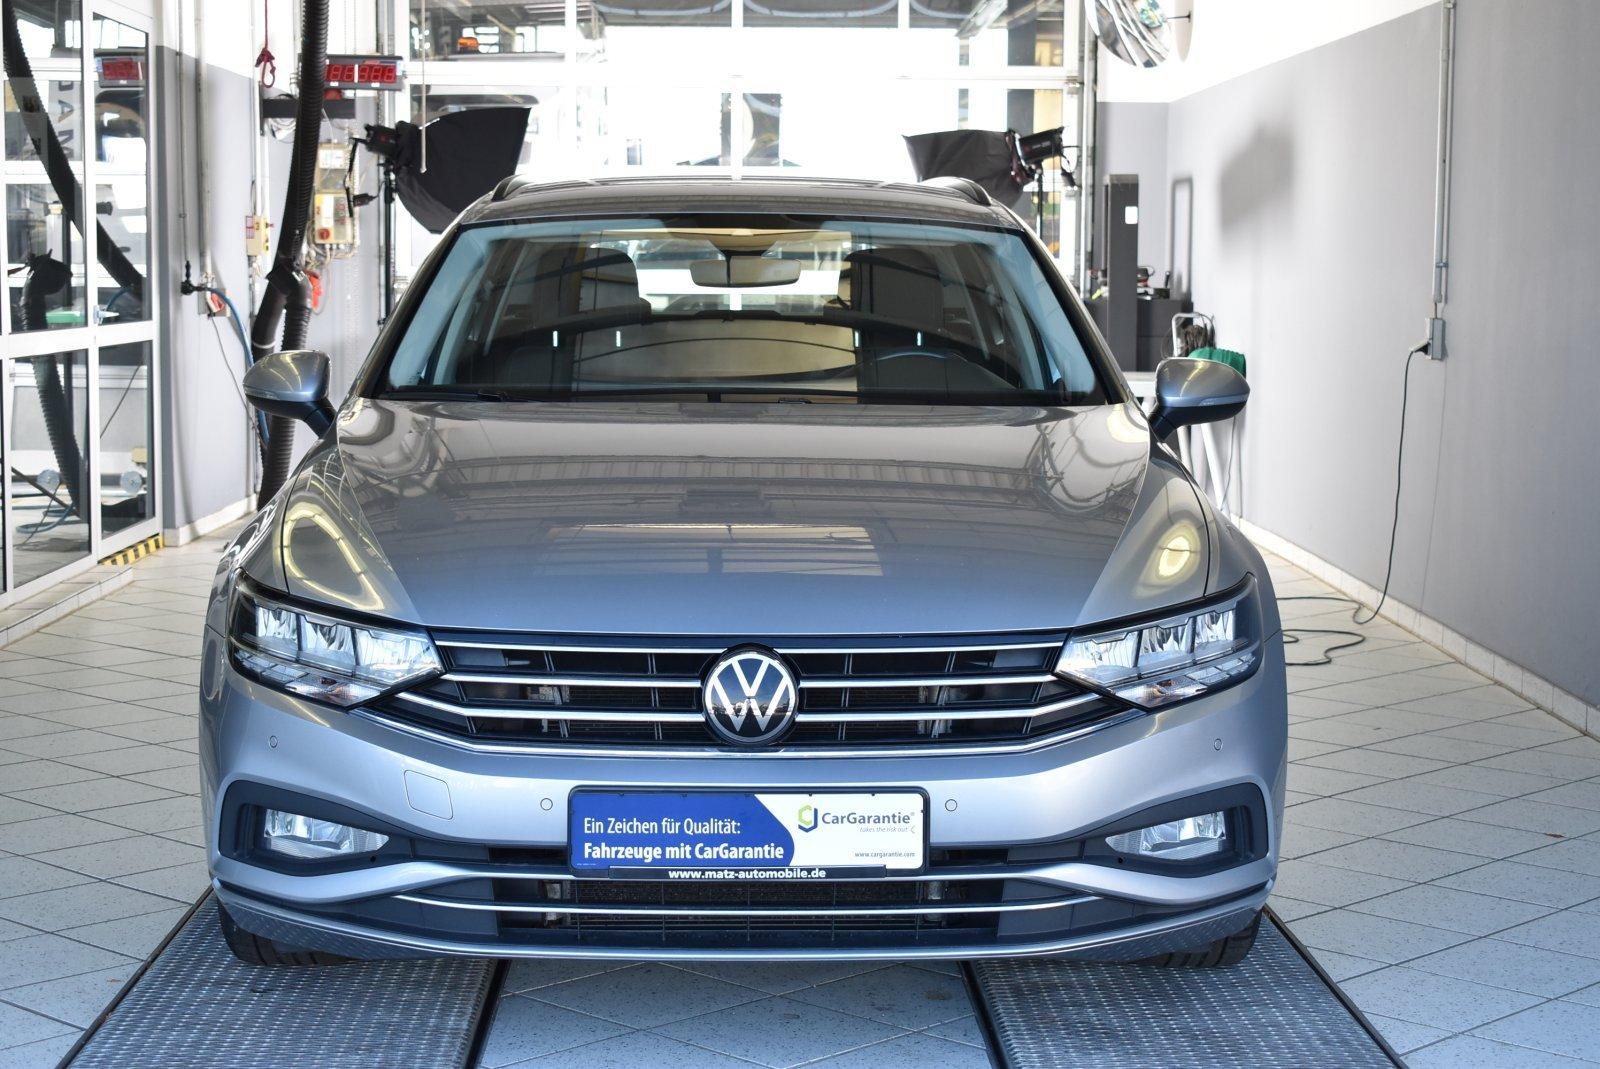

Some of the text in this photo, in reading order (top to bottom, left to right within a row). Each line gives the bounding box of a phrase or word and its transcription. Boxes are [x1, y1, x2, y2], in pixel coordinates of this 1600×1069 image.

[821, 812, 911, 824] CarGarantie
[584, 817, 741, 835] Ein Zeichen für Qualität:
[584, 842, 784, 862] Fahrzeuge mit CarGarantie
[854, 851, 916, 859] www.cargarantie.com
[668, 868, 827, 880] www.matz-automobile.de
